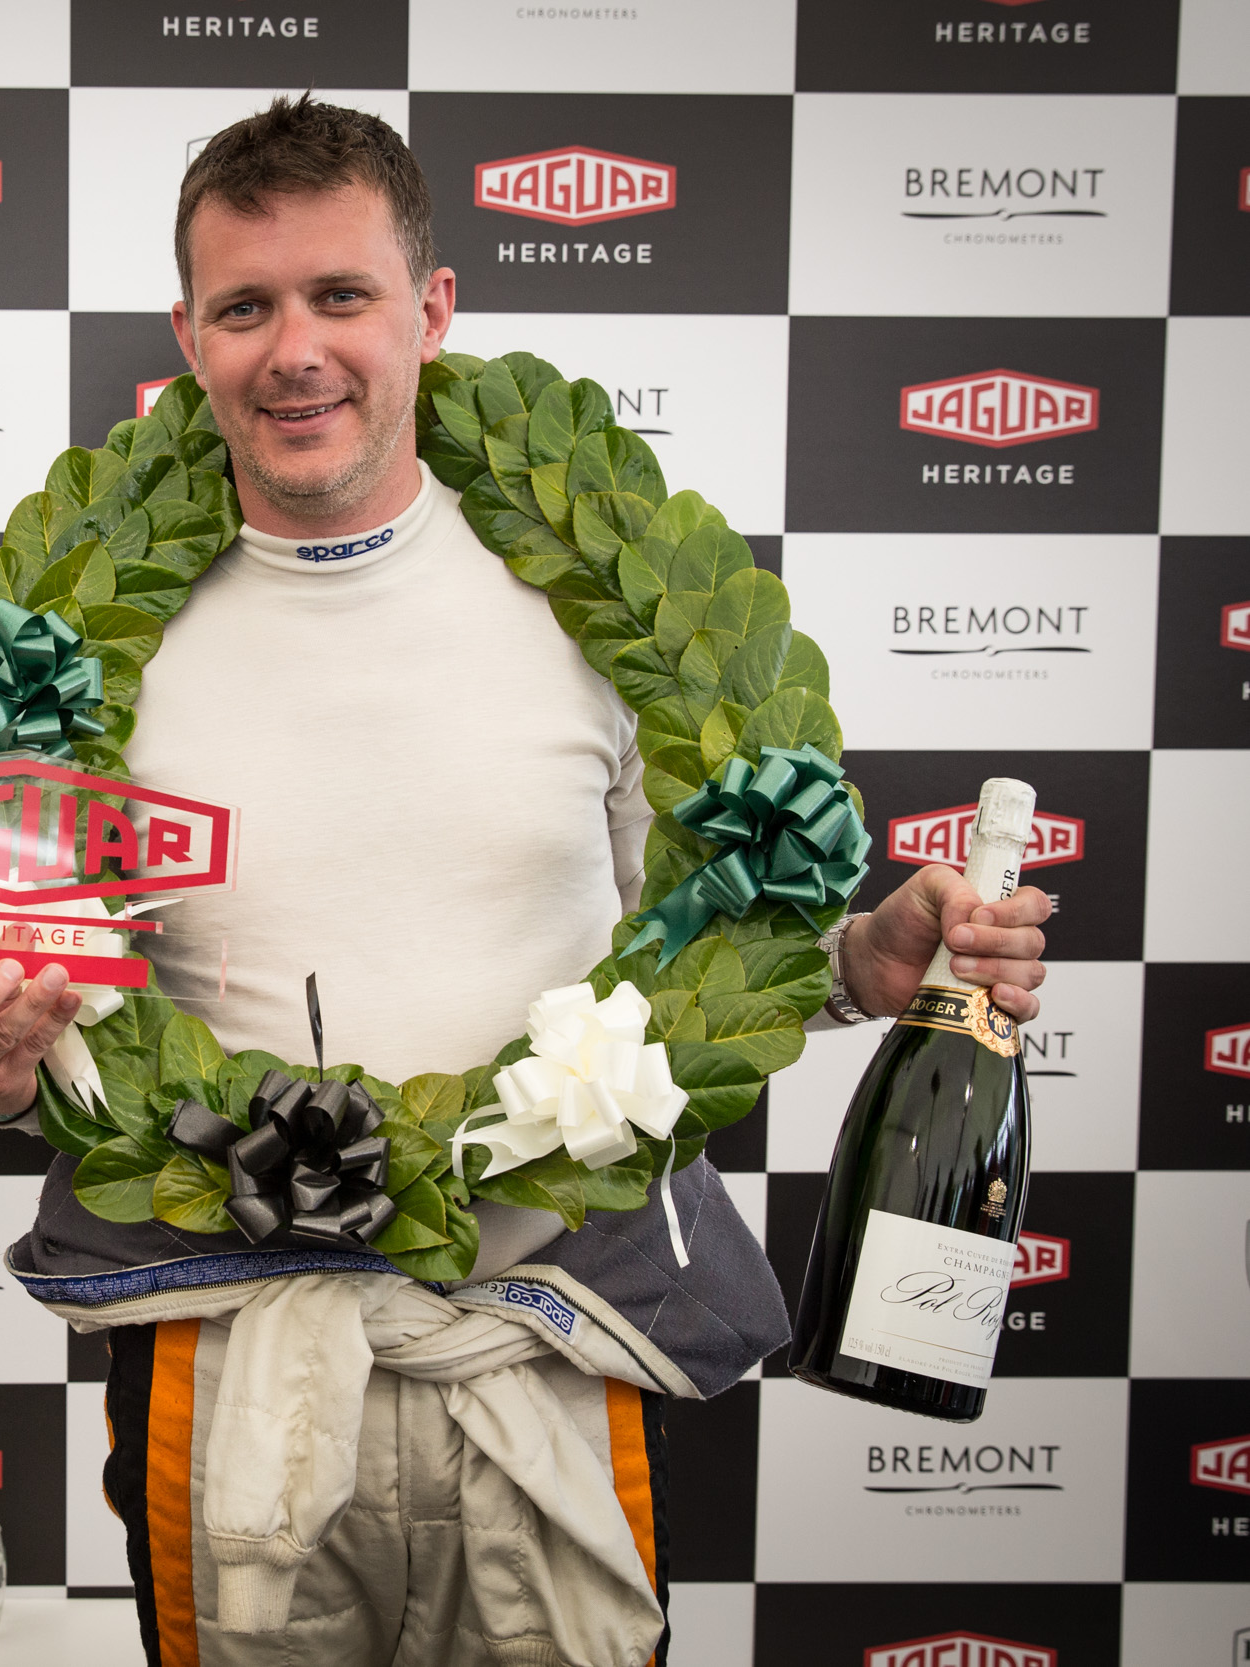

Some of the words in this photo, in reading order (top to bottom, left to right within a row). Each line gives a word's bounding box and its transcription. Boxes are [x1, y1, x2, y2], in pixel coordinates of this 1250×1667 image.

[516, 7, 638, 19] CHRONOMETERS
[162, 16, 319, 38] HERITAGE
[935, 22, 1090, 43] HERITAGE
[485, 156, 665, 216] JAGUAR
[905, 168, 1105, 198] BREMONT
[944, 233, 1064, 245] CHRONOMETERS
[498, 243, 652, 264] HERITAGE
[911, 379, 1086, 437] JAGUAR
[922, 464, 1074, 485] HERITAGE
[296, 528, 393, 562] sparco
[893, 606, 1090, 635] BREMONT
[930, 669, 1049, 681] CHRONOMETERS
[908, 997, 957, 1016] ROGER
[508, 1288, 572, 1332] sparco
[868, 1445, 1061, 1474] BREMONT
[905, 1505, 1022, 1516] CHRONOMETERS
